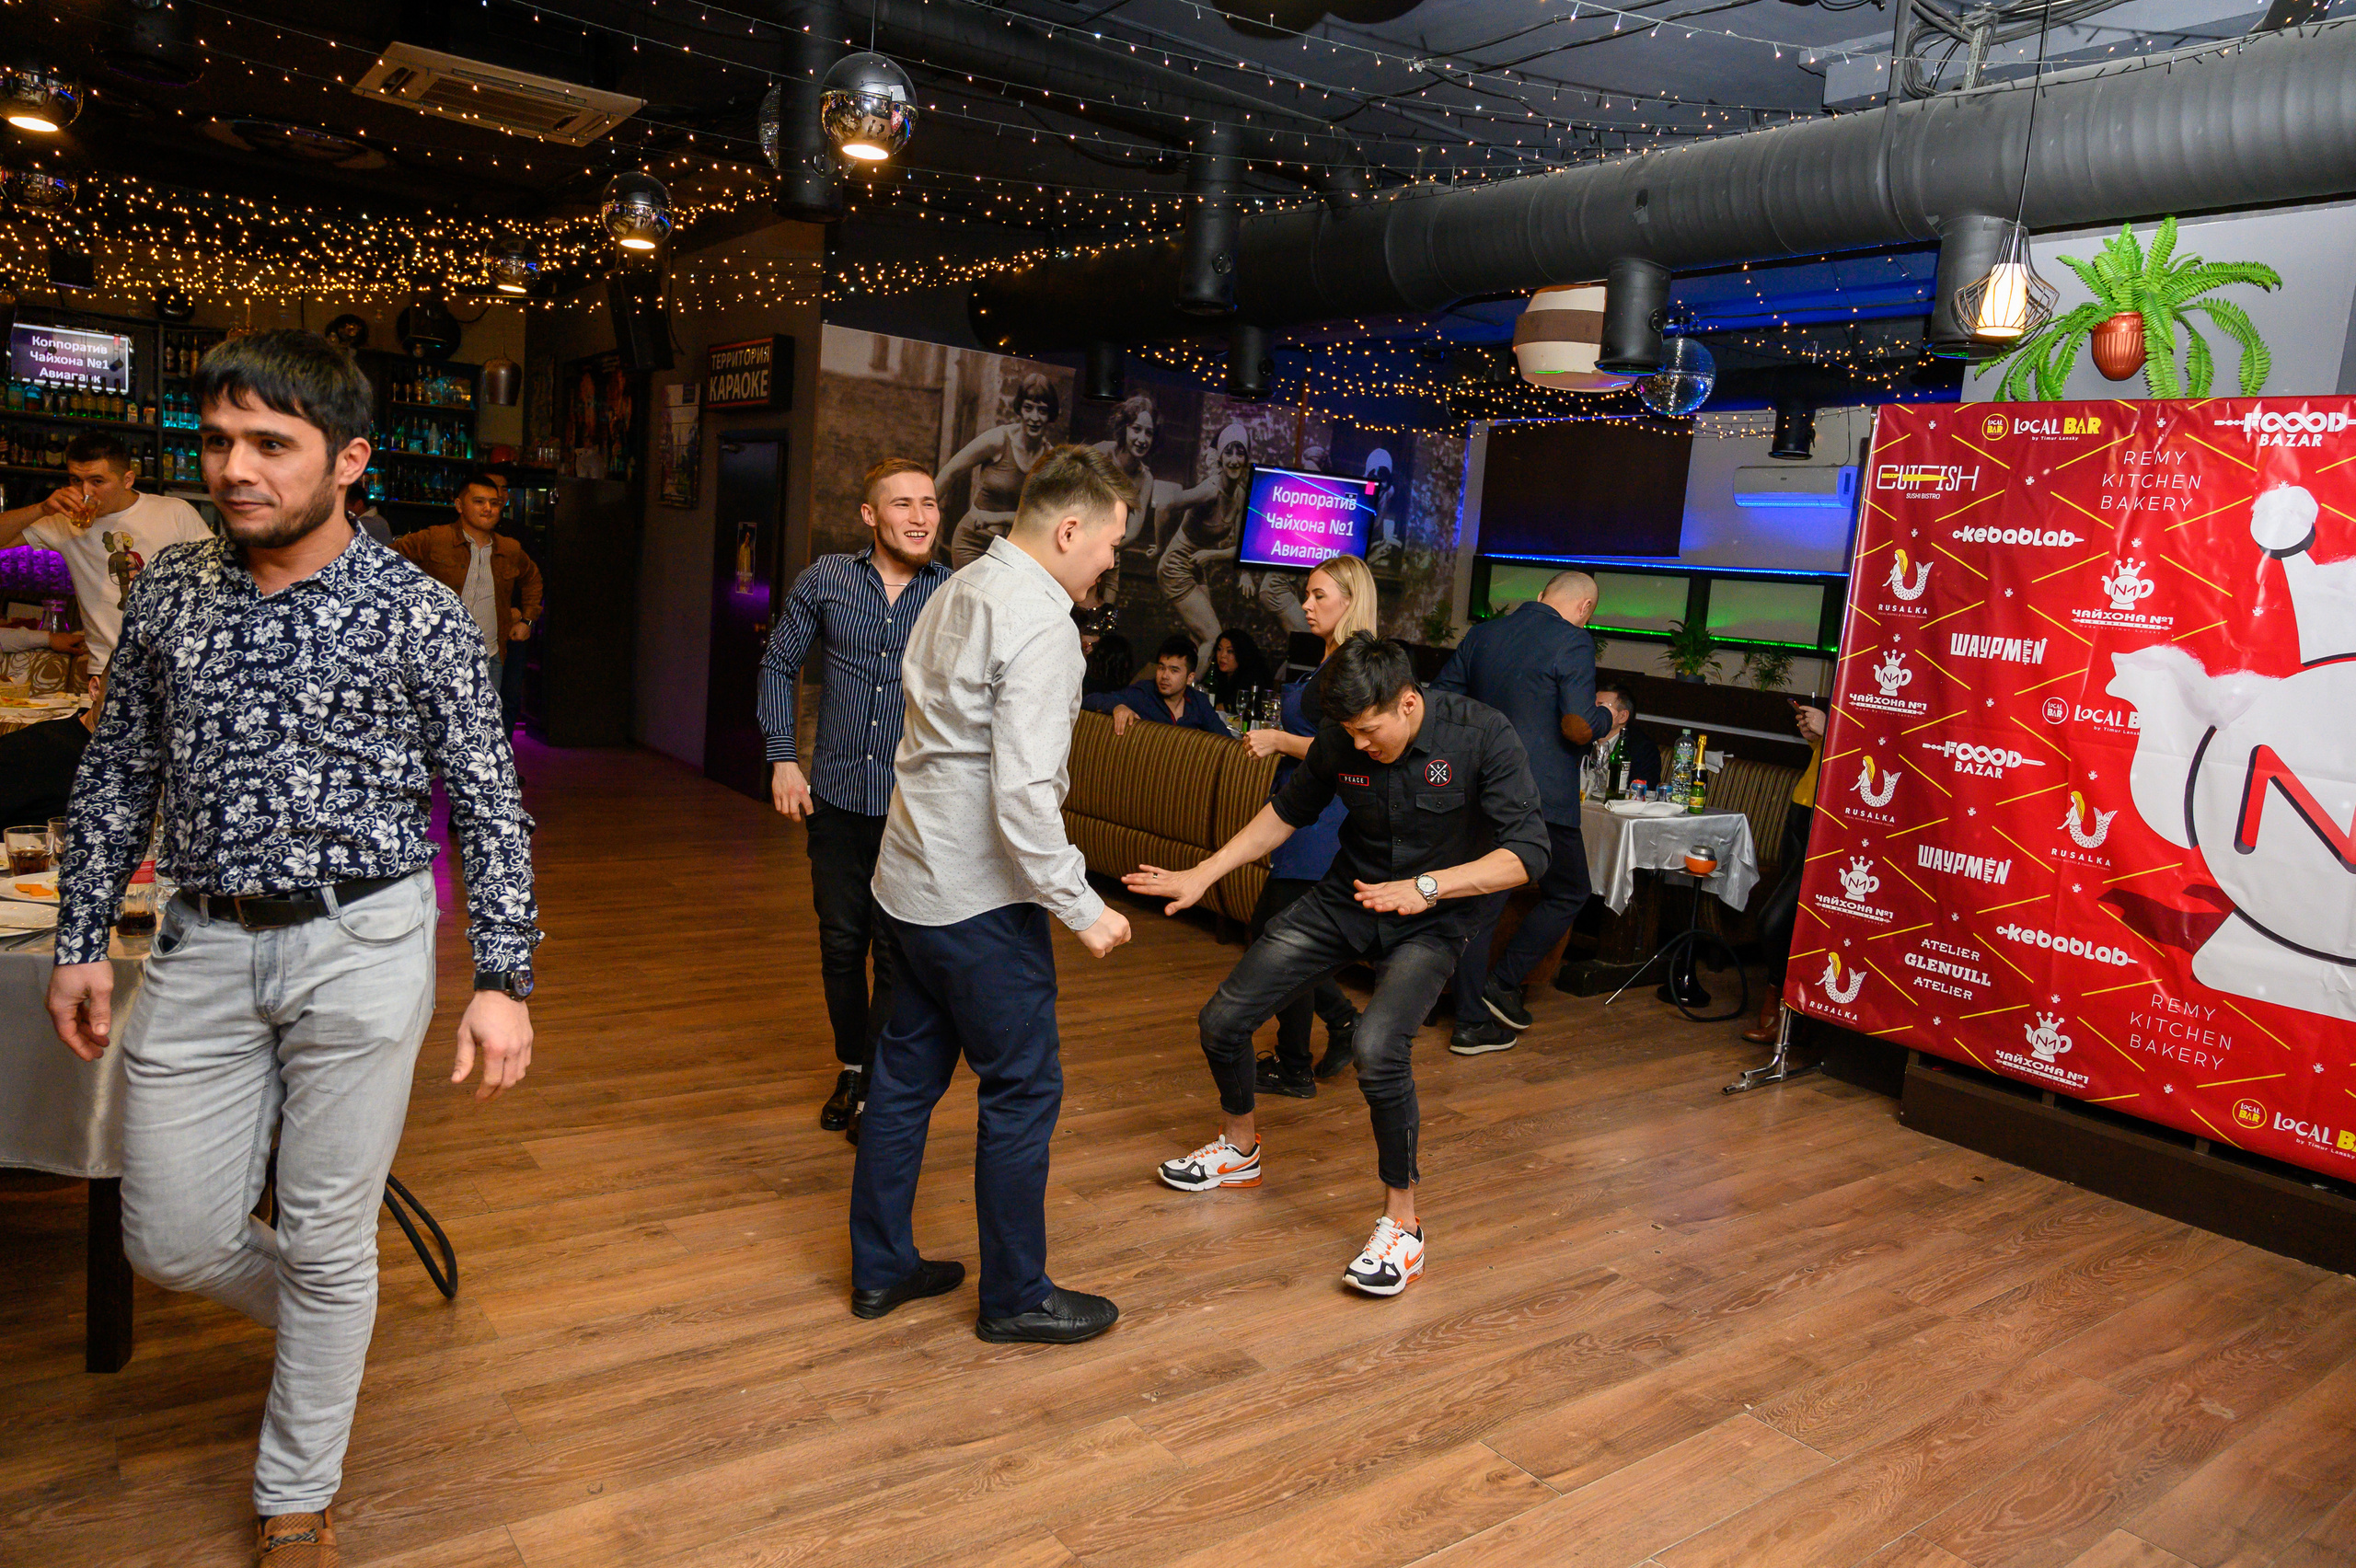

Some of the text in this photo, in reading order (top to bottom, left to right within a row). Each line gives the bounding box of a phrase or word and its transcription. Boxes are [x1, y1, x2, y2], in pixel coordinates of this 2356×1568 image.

[29, 351, 110, 370] Чайхона №1
[711, 345, 770, 371] ТЕРРИТОРИЯ
[710, 369, 769, 402] КАРАОКЕ
[1987, 425, 2003, 433] BAR
[2014, 417, 2102, 434] LOCAL BAR
[2259, 433, 2323, 447] BAZAR
[2123, 451, 2187, 466] REMY
[2102, 473, 2201, 490] KITCHEN
[1272, 486, 1357, 511] Корпоратив
[2100, 495, 2193, 512] BAKERY
[1266, 513, 1354, 536] Чайхона №1
[1878, 604, 1928, 615] RUSALKA
[2072, 608, 2146, 623] ЧАЙХОНА
[2149, 616, 2174, 625] №1
[1849, 693, 1906, 708] ЧАЙХОНА
[1908, 701, 1927, 710] №1
[2047, 708, 2062, 718] BAR
[2073, 704, 2124, 727] LOCAL
[1954, 760, 2004, 779] BAZAR
[1344, 775, 1364, 784] PEACE
[1844, 807, 1895, 823] RUSALKA
[2050, 847, 2111, 867] RUSALKA
[1815, 894, 1873, 915] ЧАЙХОНА
[1875, 908, 1894, 919] №1
[1921, 939, 1981, 962] ATELIER
[1904, 952, 1992, 987] GLENUILL
[1912, 976, 1973, 1000] ATELIER
[1809, 1000, 1858, 1020] RUSALKA
[2151, 994, 2216, 1021] REMY
[2130, 1011, 2232, 1051] KITCHEN
[2130, 1033, 2224, 1070] BAKERY
[1995, 1050, 2064, 1077] ЧАЙХОНА
[2067, 1071, 2089, 1084] №1
[2238, 1109, 2260, 1123] BAR
[2240, 1102, 2260, 1114] LOCAL
[2272, 1112, 2333, 1146] LOCAL
[2307, 1142, 2329, 1151] Timur
[2330, 1148, 2356, 1159] Lansky
